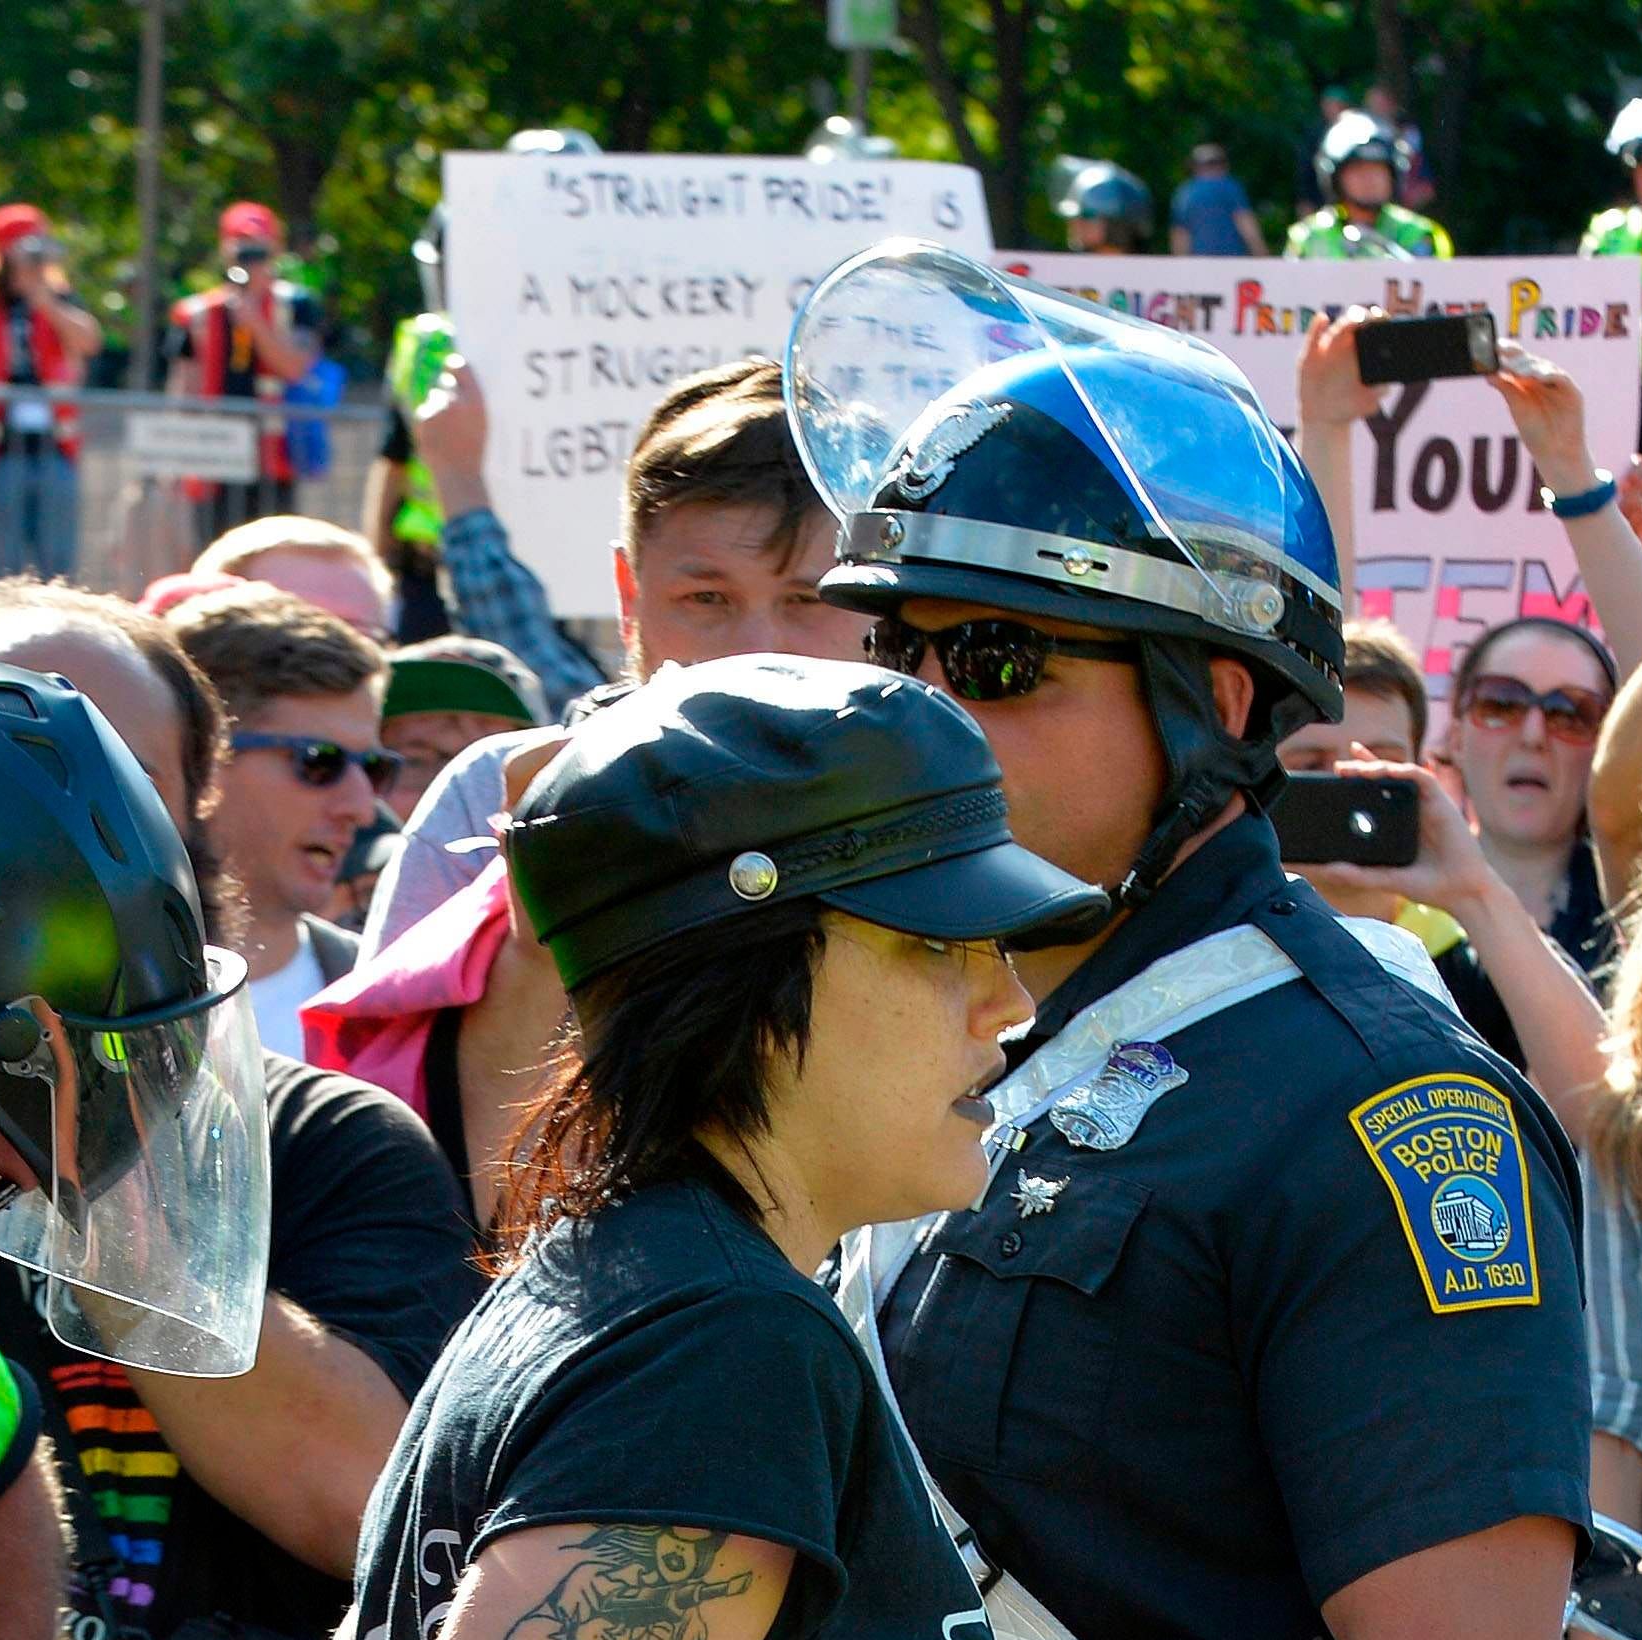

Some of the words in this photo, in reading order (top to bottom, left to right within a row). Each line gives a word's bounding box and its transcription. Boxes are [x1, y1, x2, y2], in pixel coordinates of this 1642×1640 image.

[521, 272, 551, 315] A
[568, 273, 764, 319] MOCKERY
[1507, 277, 1629, 338] PRIDE
[1365, 1094, 1429, 1135] SPECIAL
[1427, 1088, 1506, 1122] OPERATIONS
[1392, 1126, 1503, 1168] BOSTON
[1414, 1150, 1500, 1184] POLICE
[1444, 1264, 1483, 1295] A.D.
[1486, 1262, 1526, 1288] 1630
